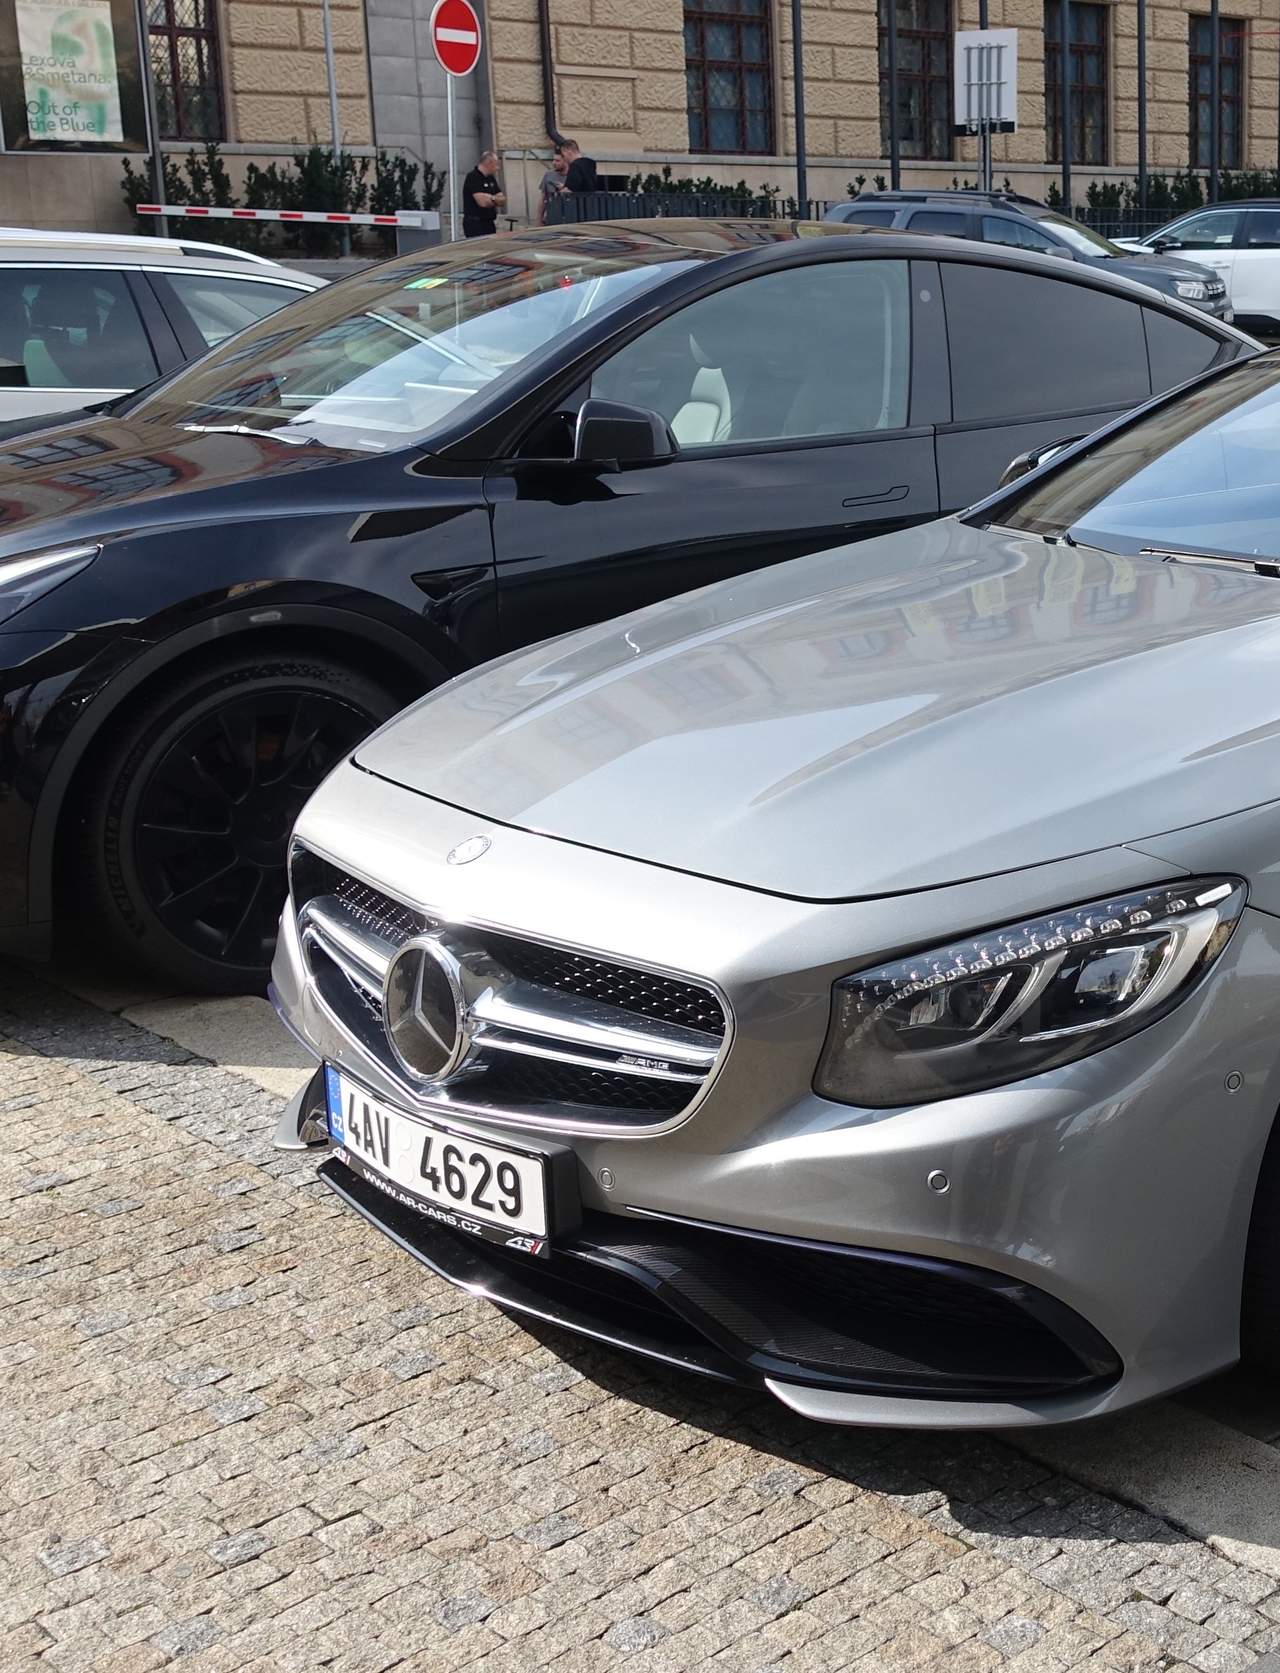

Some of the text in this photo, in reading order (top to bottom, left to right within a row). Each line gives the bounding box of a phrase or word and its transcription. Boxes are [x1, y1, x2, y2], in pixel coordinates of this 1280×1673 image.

[26, 100, 80, 116] Out of
[29, 117, 96, 132] the Blue
[331, 1092, 523, 1218] CZ 4AV 4629
[362, 1168, 483, 1236] WWW.AR-CARS.CZ
